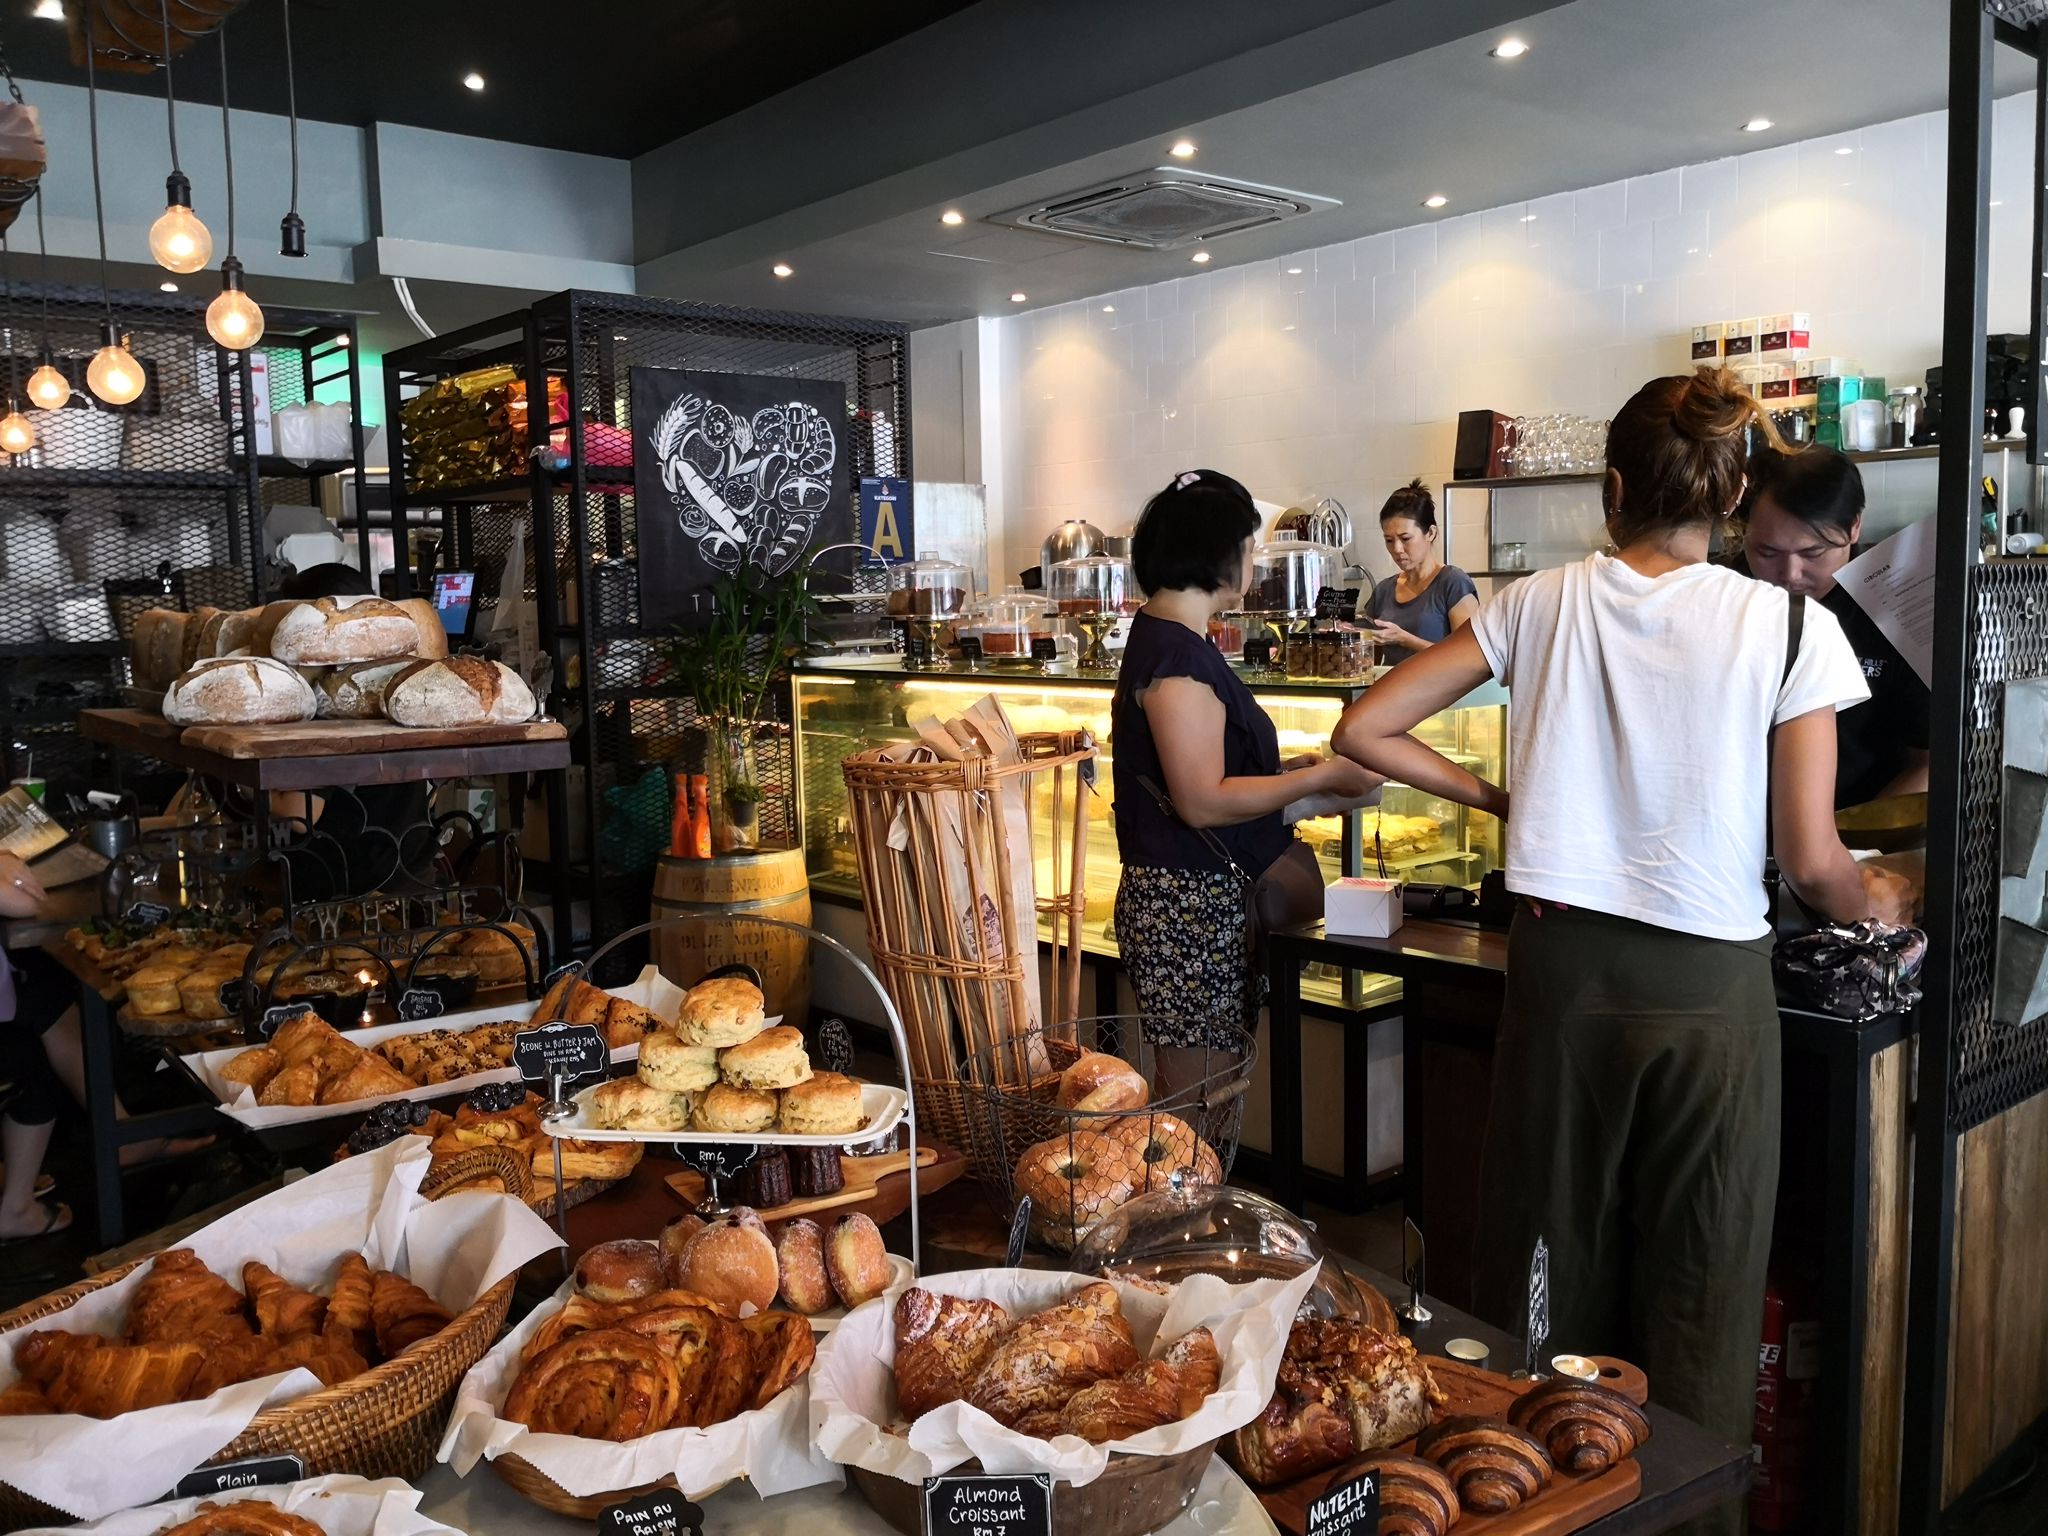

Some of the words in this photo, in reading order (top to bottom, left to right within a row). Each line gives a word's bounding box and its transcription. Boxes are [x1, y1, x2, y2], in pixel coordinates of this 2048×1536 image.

[871, 501, 904, 557] A
[1863, 564, 1891, 583] CIRCULAR
[315, 890, 478, 940] WHITE
[520, 1041, 543, 1053] SCONE
[553, 1037, 577, 1049] BUTTER
[582, 1036, 597, 1048] JAM
[216, 1473, 258, 1489] Plain
[954, 1485, 1022, 1504] Almond
[1310, 1476, 1374, 1530] NUTELLA
[613, 1509, 650, 1525] PAIN
[653, 1503, 672, 1517] AU
[949, 1504, 1026, 1524] Croissant
